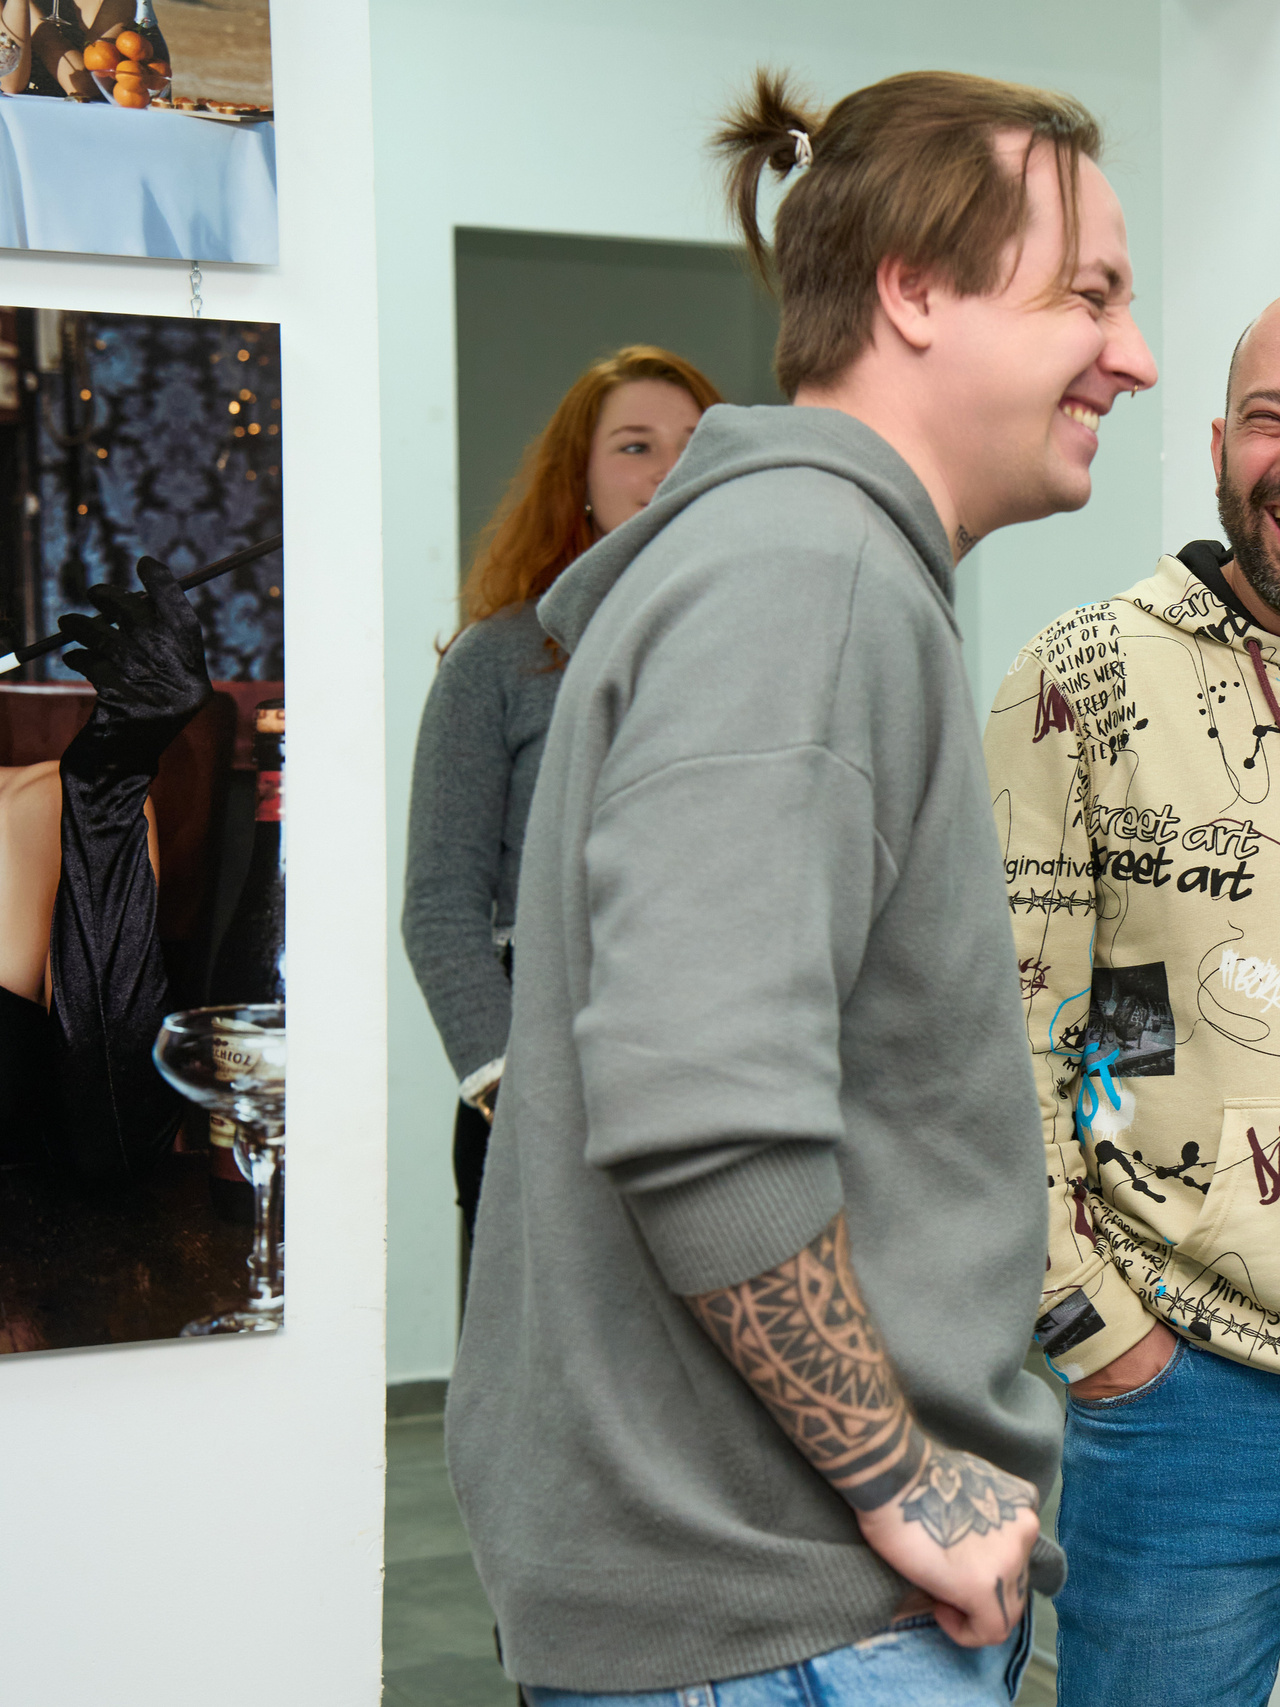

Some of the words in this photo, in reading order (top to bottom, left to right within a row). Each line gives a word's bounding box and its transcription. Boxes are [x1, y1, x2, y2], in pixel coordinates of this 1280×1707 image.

[1046, 611, 1117, 648] SOMETIMES
[1047, 635, 1073, 663] OUT
[1080, 626, 1099, 642] OF
[1094, 661, 1128, 684] WERE
[1096, 701, 1136, 737] KNOWN
[1182, 820, 1263, 860] art
[1177, 861, 1256, 902] art
